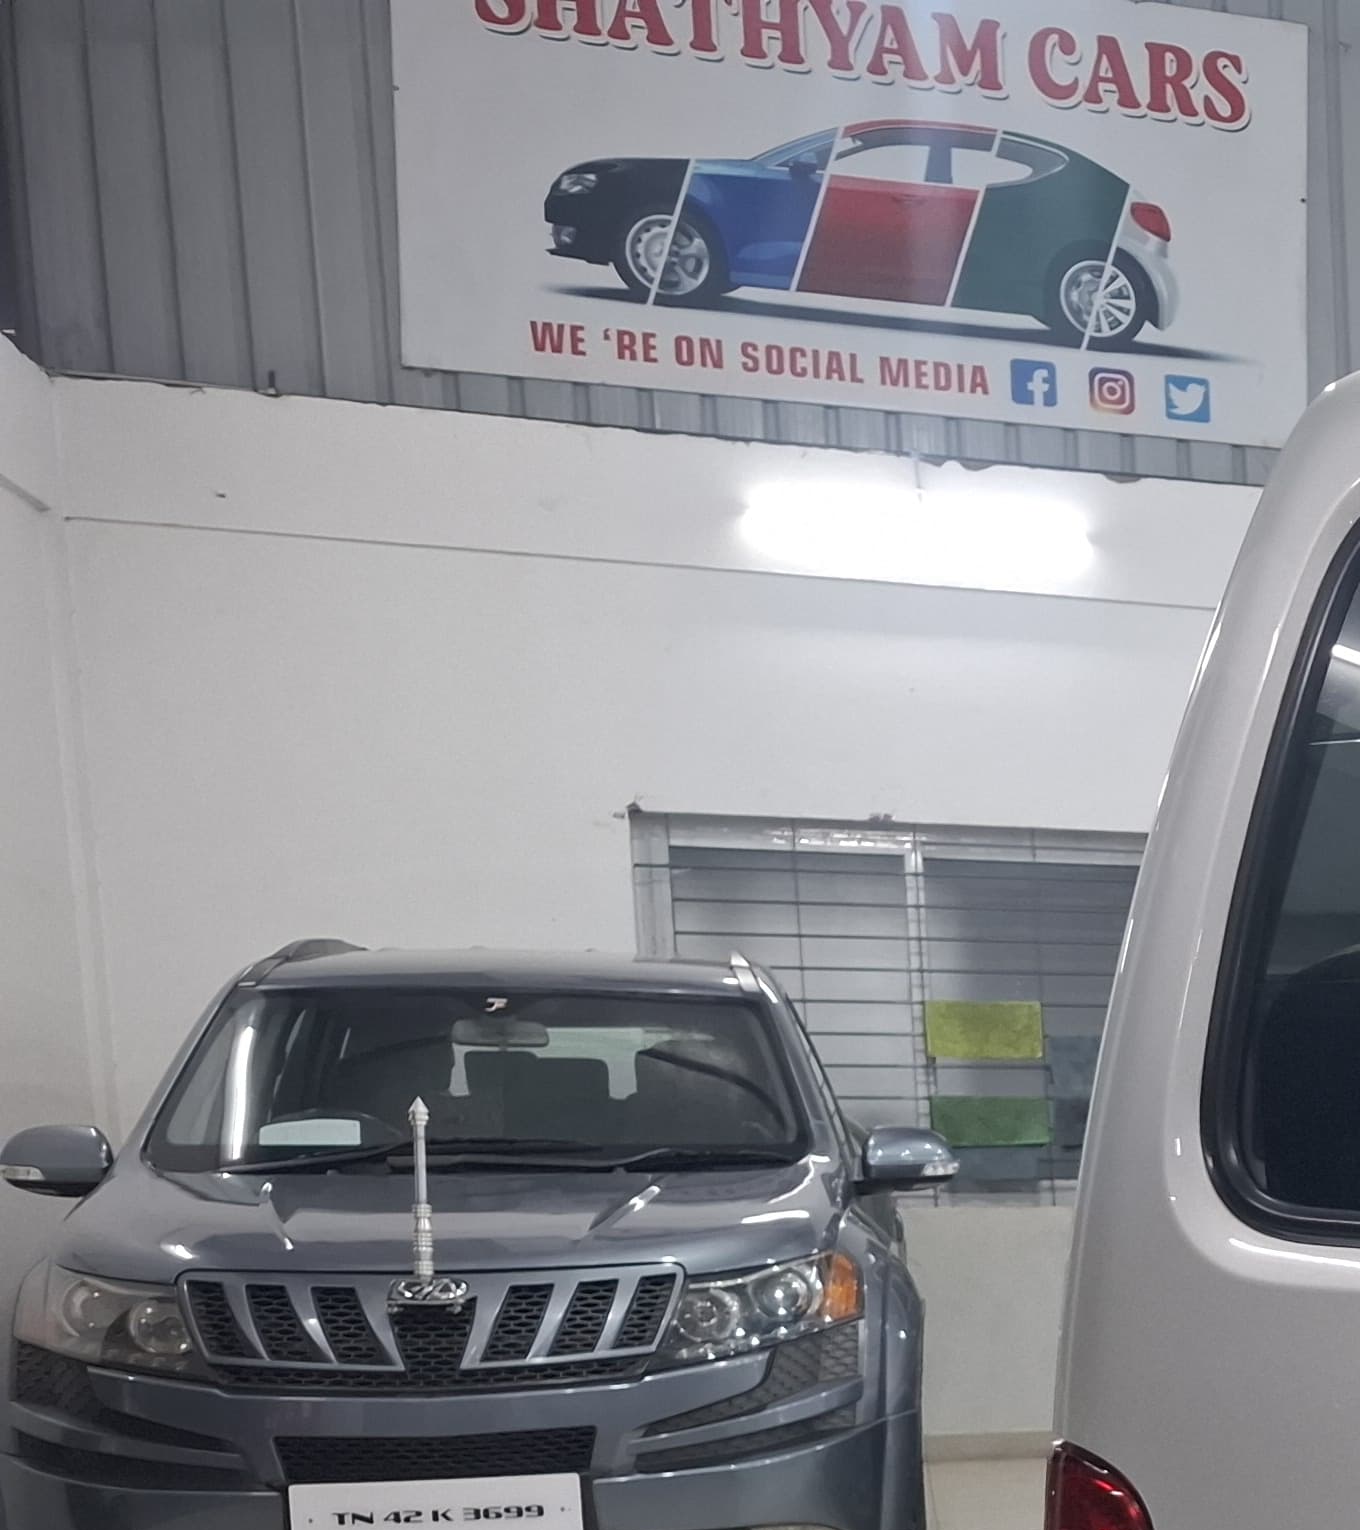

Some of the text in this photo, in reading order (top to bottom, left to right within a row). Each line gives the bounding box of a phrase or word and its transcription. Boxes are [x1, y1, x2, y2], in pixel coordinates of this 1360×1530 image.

[1027, 26, 1247, 125] CARS
[529, 319, 587, 357] WE
[673, 334, 725, 369] ON
[739, 340, 865, 385] SOCIAL
[878, 356, 991, 396] MEDIA
[332, 1504, 545, 1526] TN 42 K 3699
